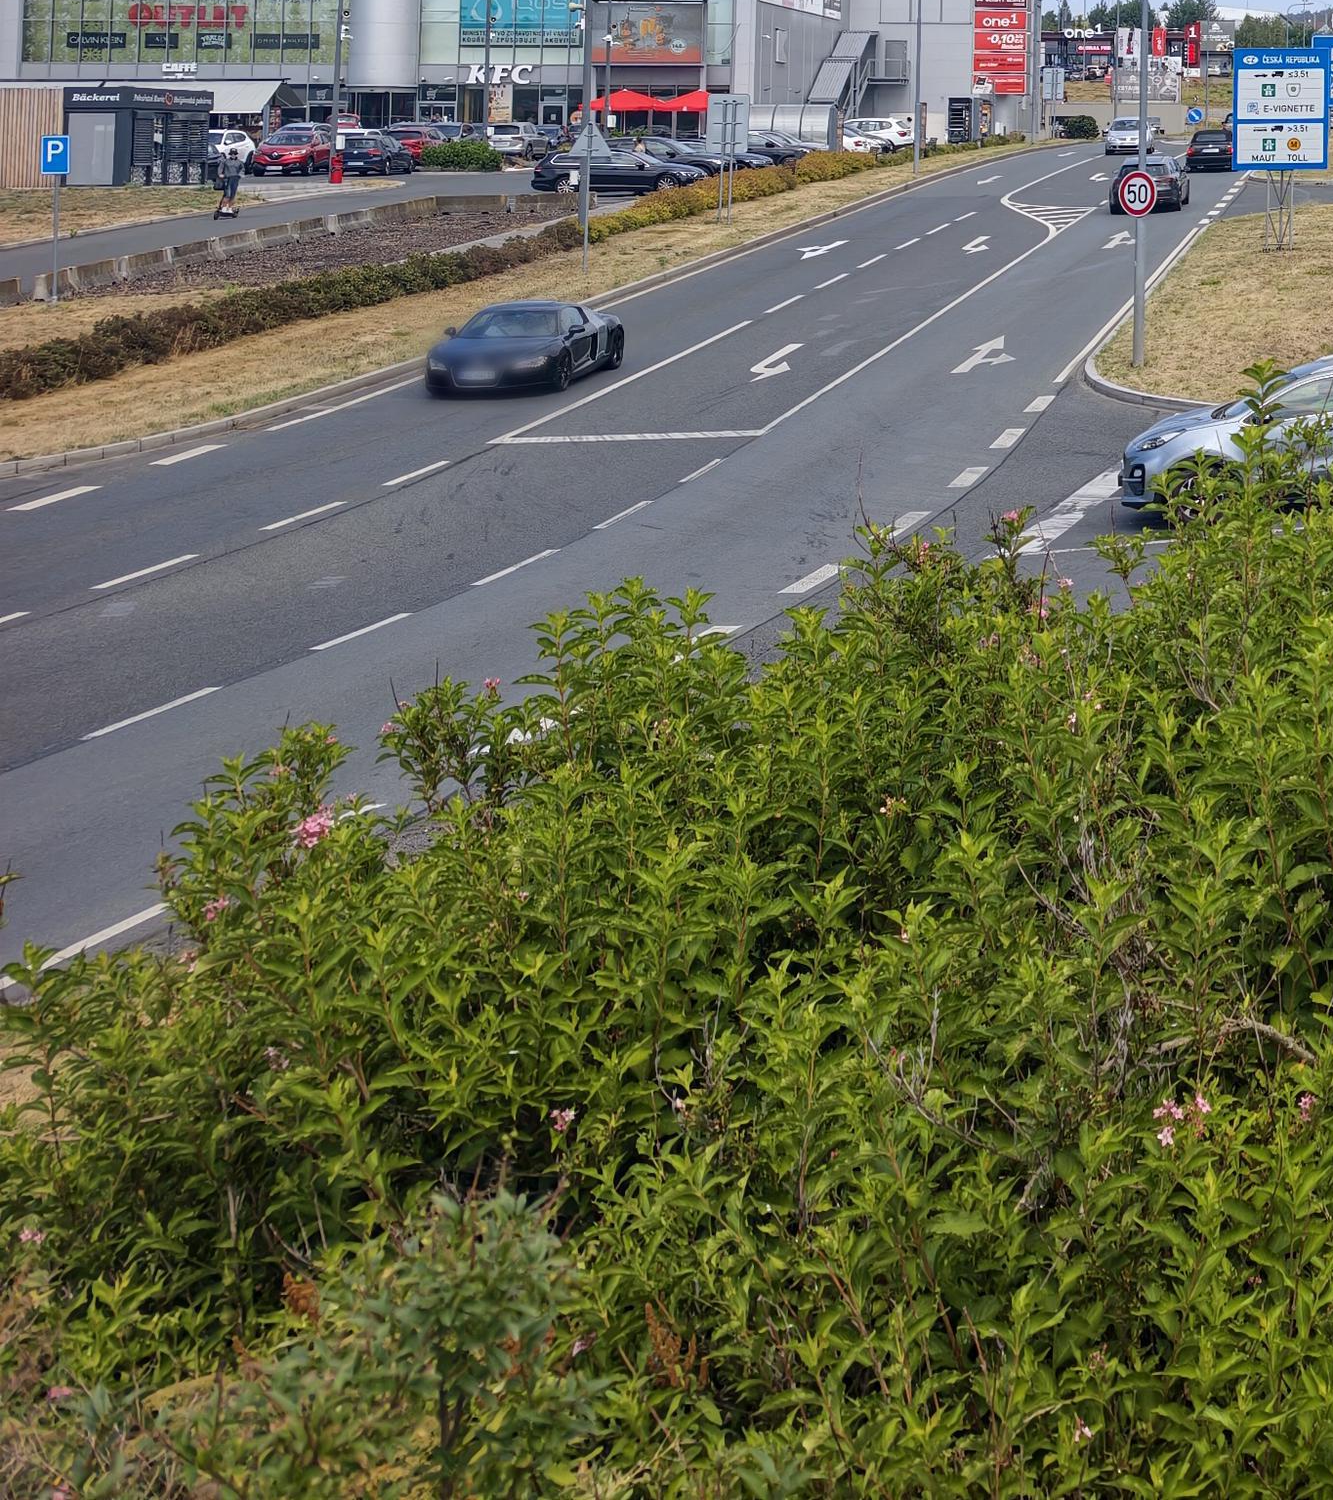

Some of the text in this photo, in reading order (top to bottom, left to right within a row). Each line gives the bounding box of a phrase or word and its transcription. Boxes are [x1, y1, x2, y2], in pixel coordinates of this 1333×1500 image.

[127, 3, 249, 28] OUTLET
[1189, 26, 1197, 38] 1
[69, 36, 99, 45] CALVIN
[1262, 55, 1283, 64] ČESKÁ
[1285, 56, 1320, 64] REPUBLIKA
[465, 64, 533, 85] KFC
[72, 93, 120, 101] Bäckerei
[1263, 104, 1315, 112] E-VIGNETTE
[47, 140, 64, 162] P
[1127, 183, 1148, 204] 50
